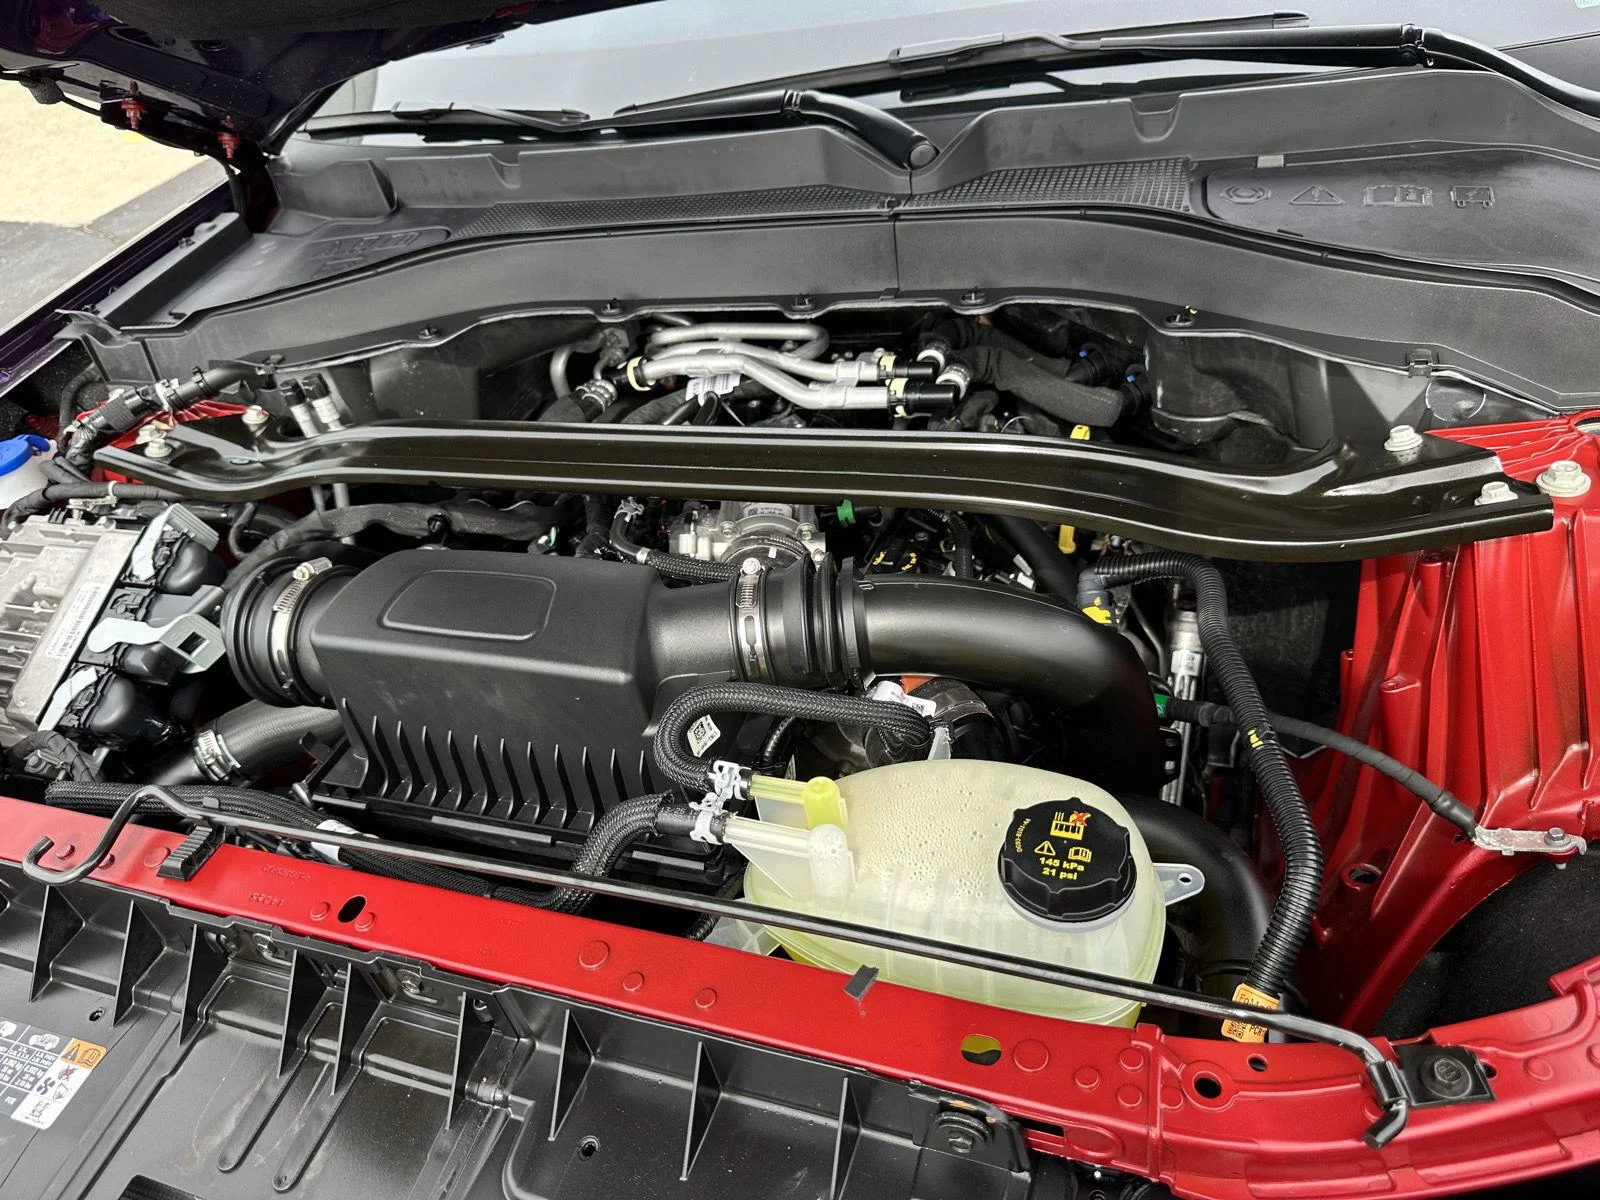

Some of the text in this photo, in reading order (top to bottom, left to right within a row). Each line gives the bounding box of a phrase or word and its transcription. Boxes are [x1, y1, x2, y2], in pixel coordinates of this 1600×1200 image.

[1039, 857, 1085, 872] 145 kPa
[1042, 867, 1078, 880] 21 psi
